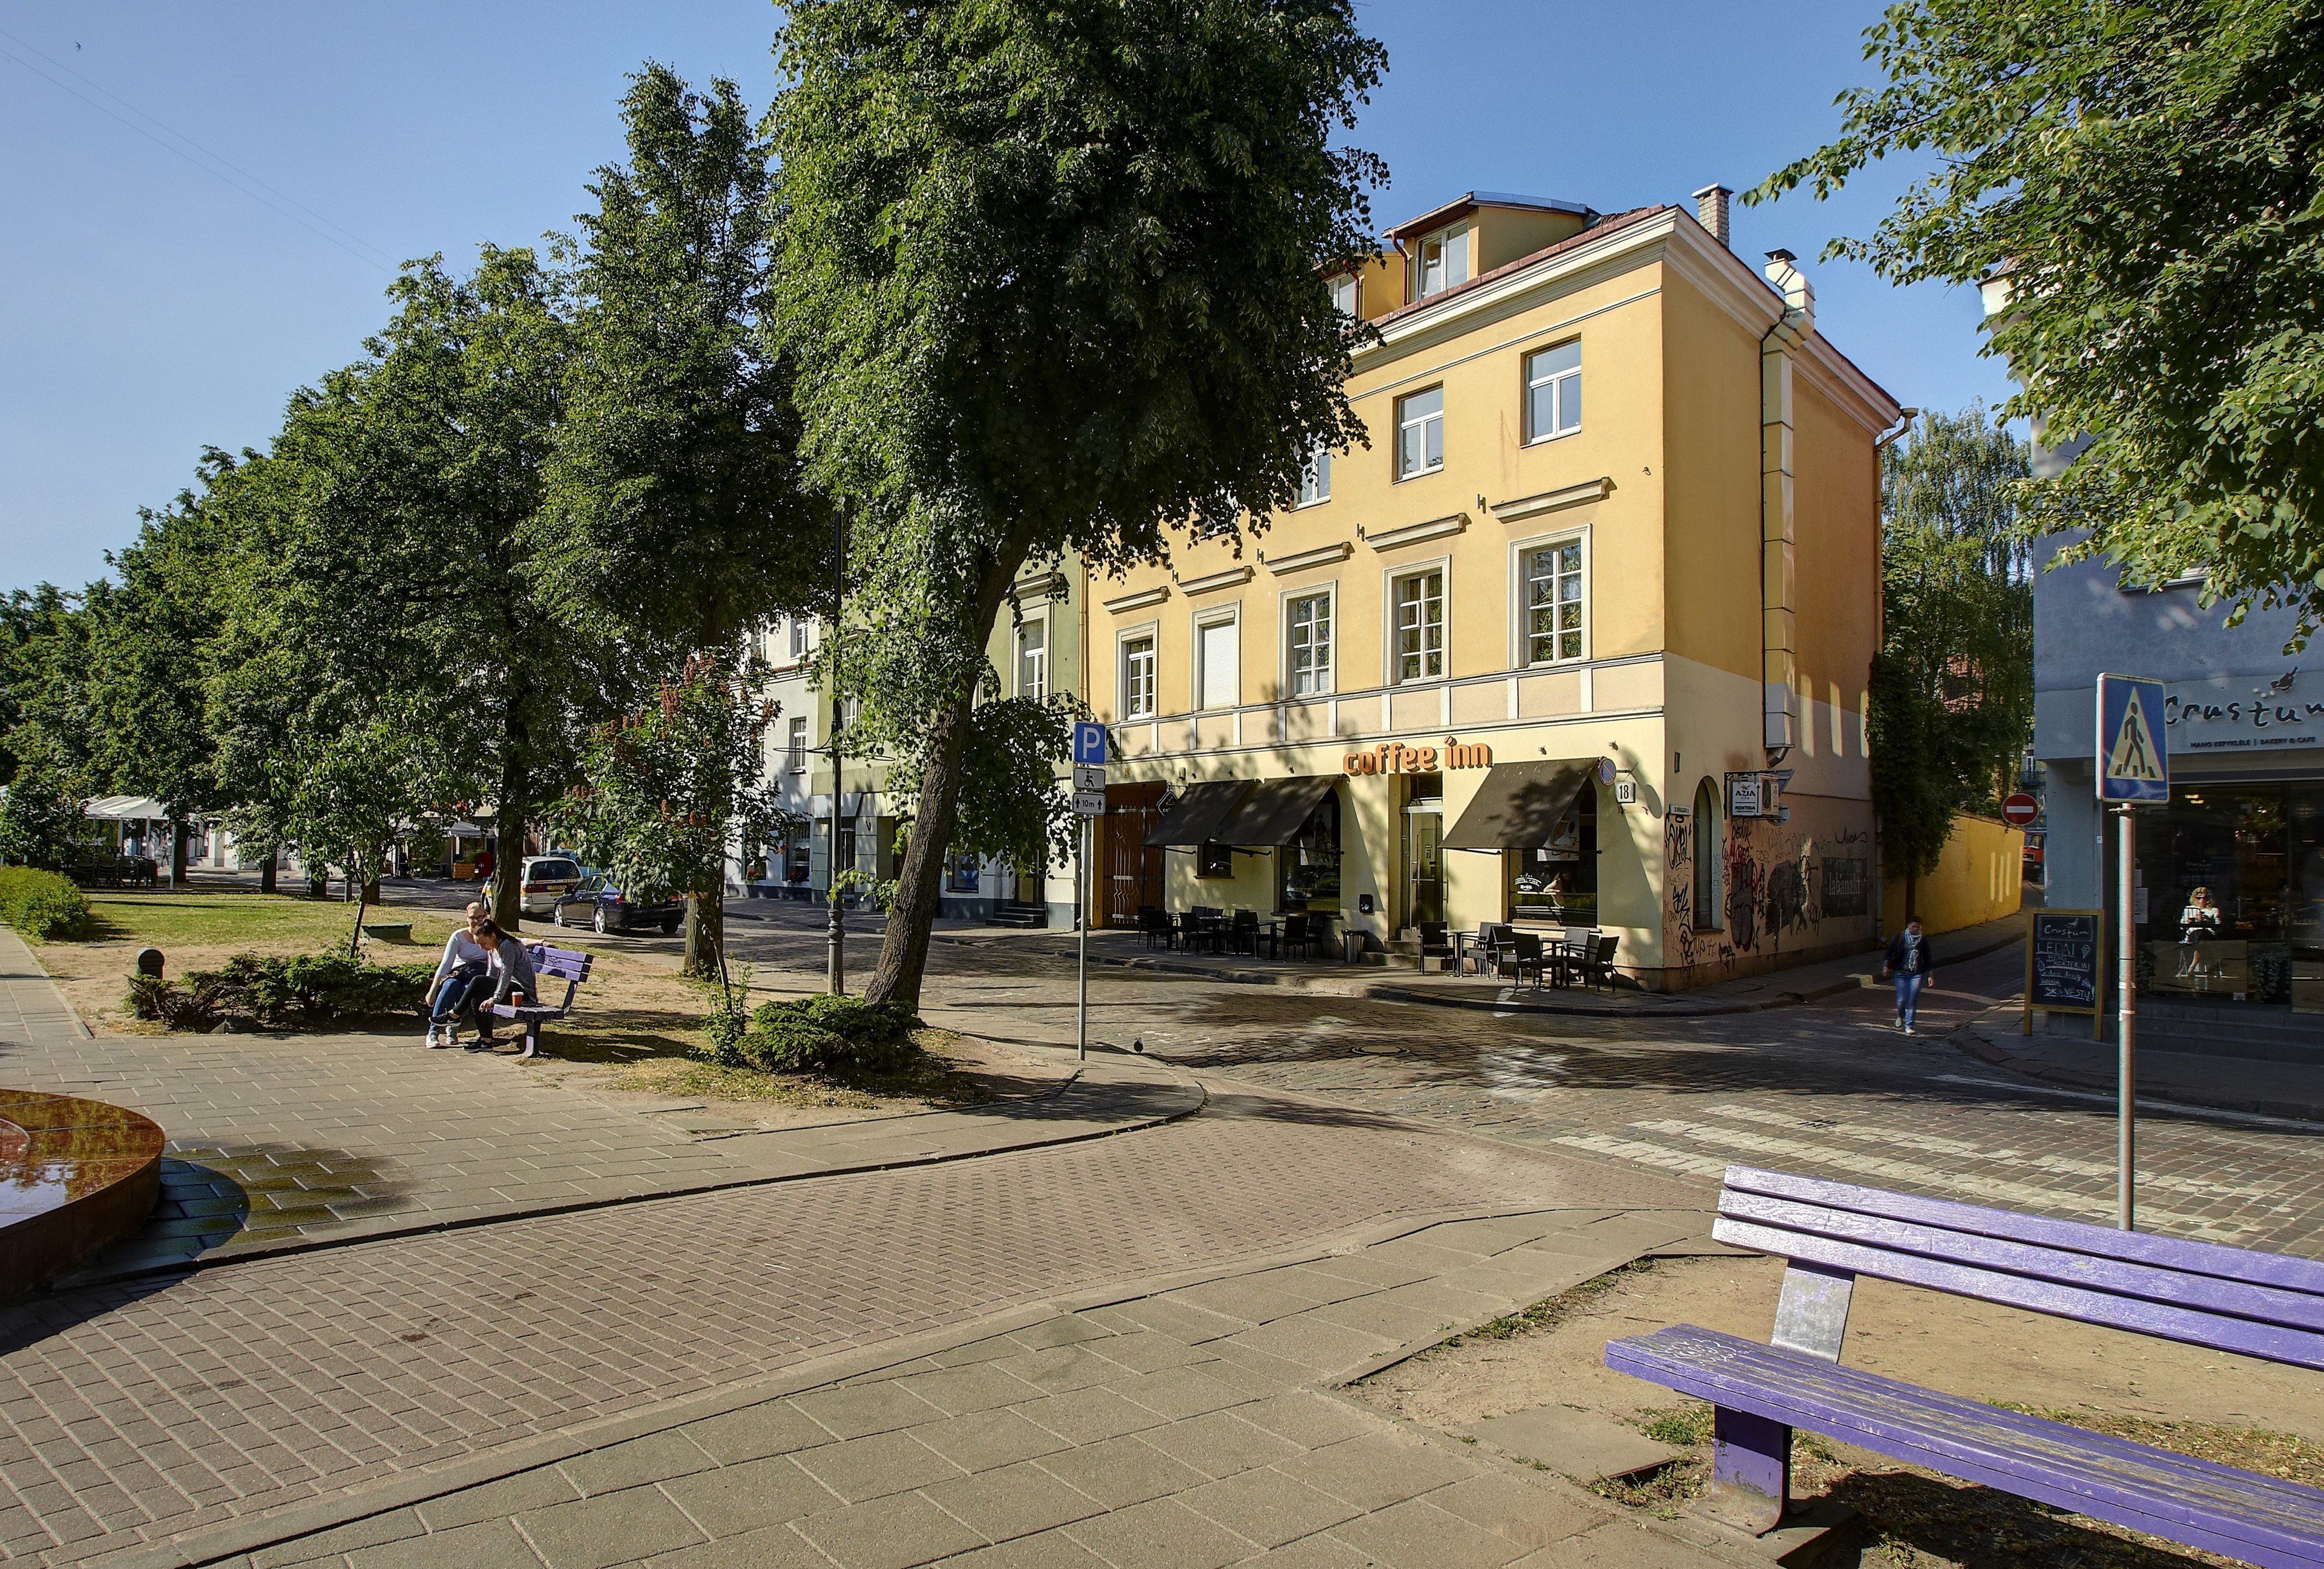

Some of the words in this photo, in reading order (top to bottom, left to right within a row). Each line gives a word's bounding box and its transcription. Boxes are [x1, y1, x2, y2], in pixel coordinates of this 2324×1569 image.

[1083, 727, 1100, 759] P
[1343, 742, 1437, 776] coffee
[1445, 735, 1492, 770] inn
[1620, 785, 1629, 799] 18
[2044, 925, 2088, 938] Crustum
[2037, 942, 2074, 956] LEDAI
